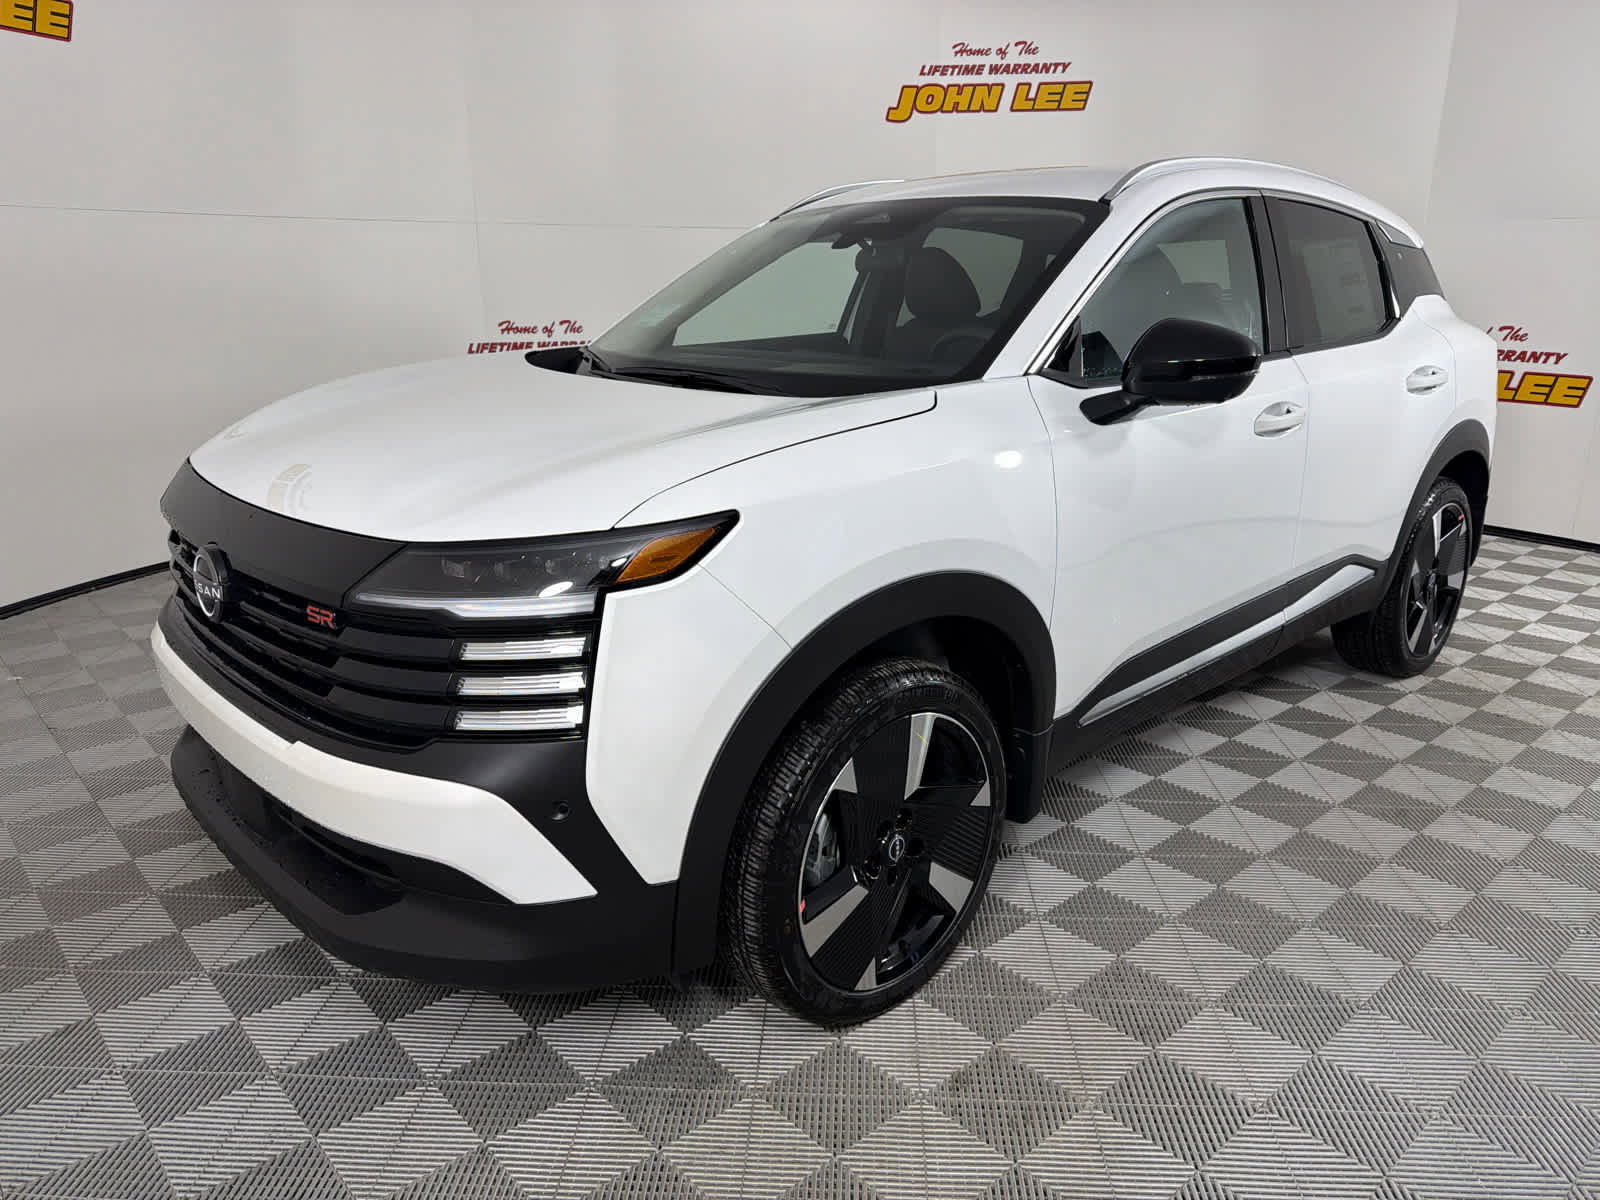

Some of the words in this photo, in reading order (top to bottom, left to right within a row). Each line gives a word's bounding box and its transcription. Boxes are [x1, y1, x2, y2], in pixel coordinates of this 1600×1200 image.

[952, 42, 992, 57] Home
[996, 43, 1010, 60] of
[1014, 40, 1040, 56] The
[919, 64, 985, 77] LIFETIME
[988, 62, 1072, 75] WARRANTY
[885, 83, 1005, 123] JOHN
[1010, 80, 1093, 112] LEE
[498, 320, 539, 335] Home
[541, 321, 555, 338] of
[559, 319, 584, 334] The
[1498, 325, 1529, 342] The
[467, 341, 534, 355] LIFETIME
[306, 605, 336, 630] SR
